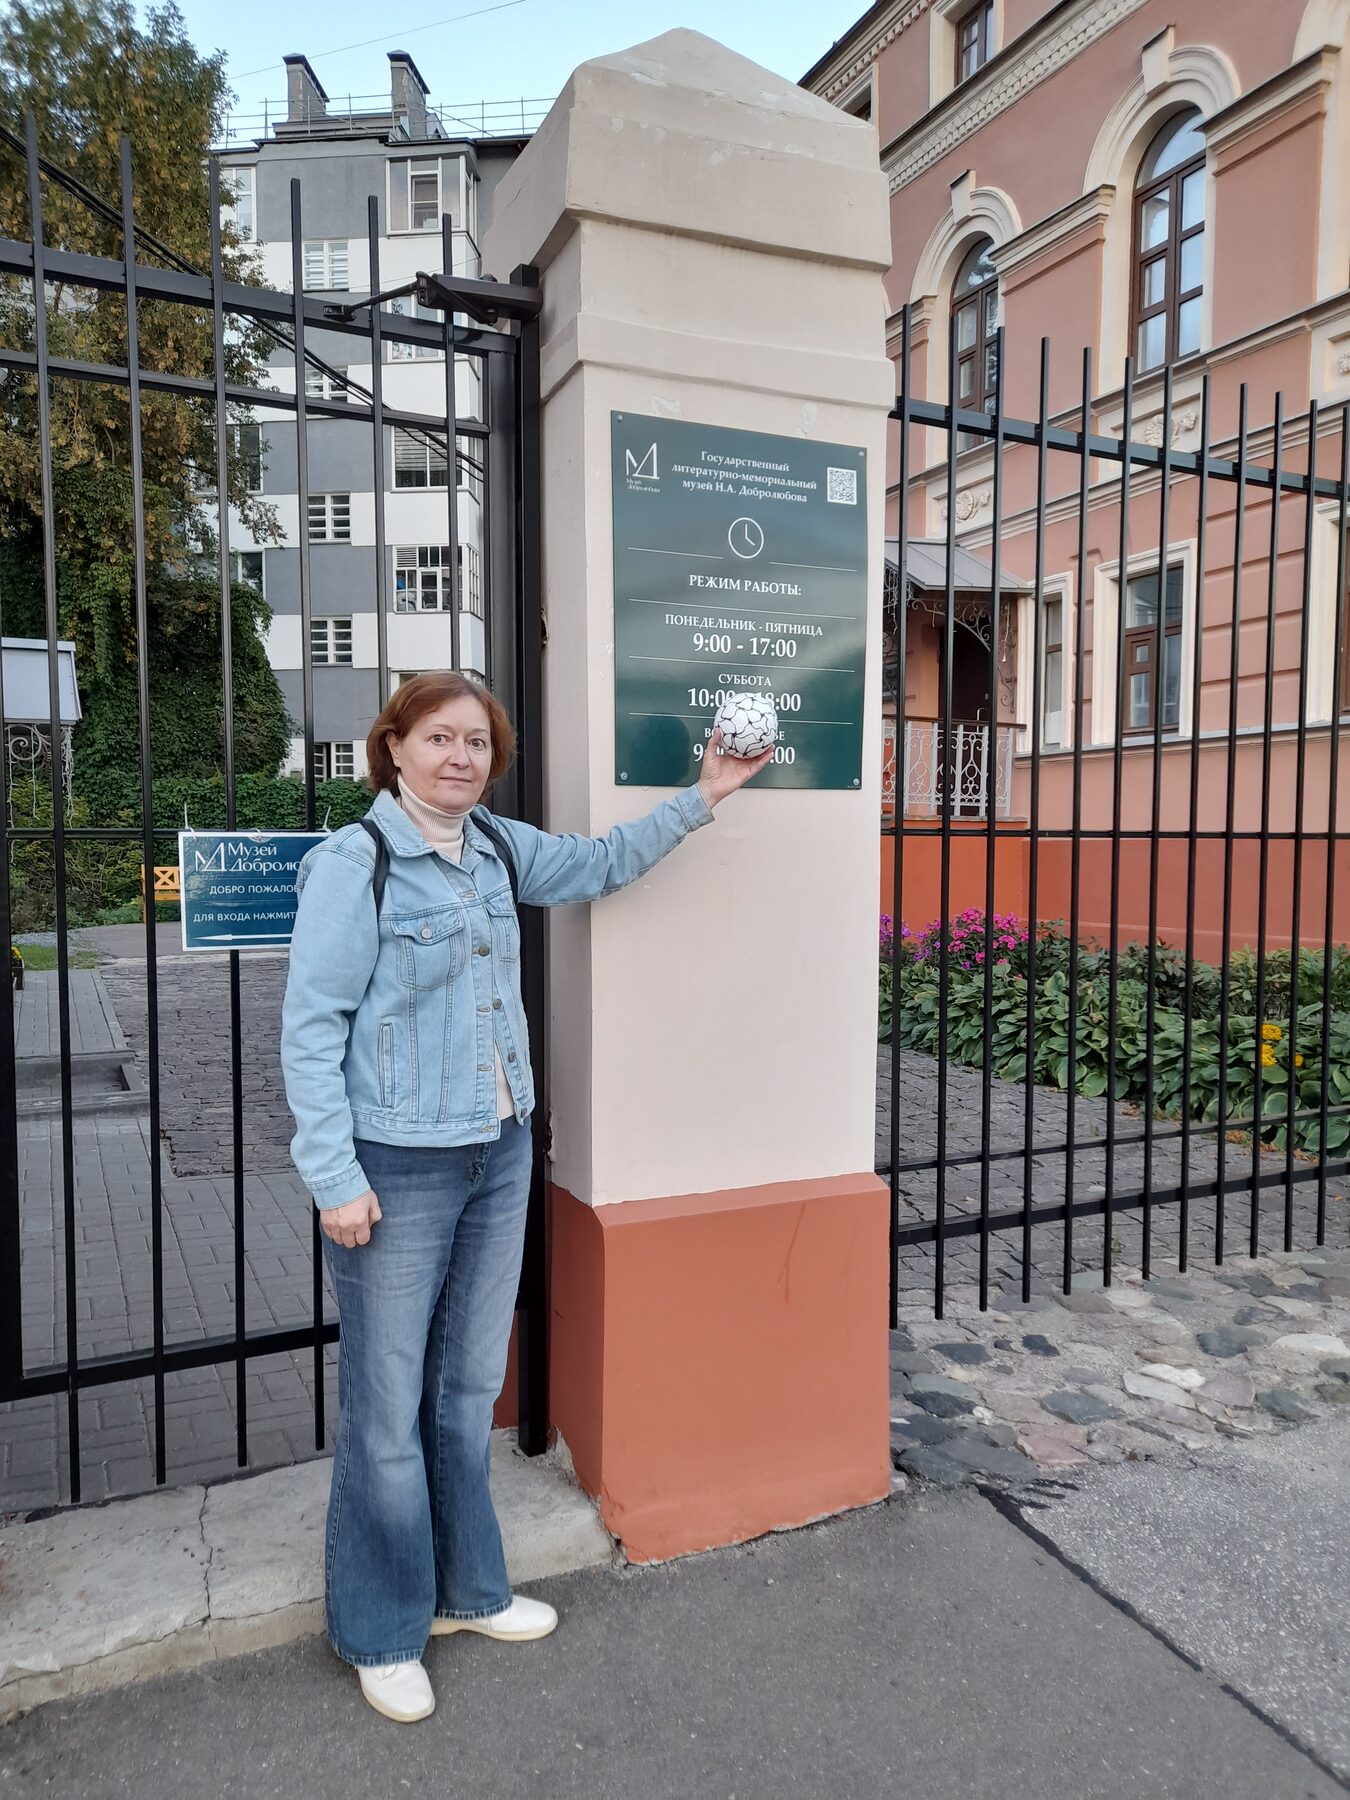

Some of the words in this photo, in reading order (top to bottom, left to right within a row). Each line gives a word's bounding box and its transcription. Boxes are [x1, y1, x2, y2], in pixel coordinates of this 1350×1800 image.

[701, 450, 790, 472] Государственный
[671, 464, 818, 490] литературно-мемориальный
[682, 479, 713, 491] музей
[715, 482, 737, 494] Н.А.
[738, 485, 807, 502] Добролюбова
[689, 574, 741, 591] РЕЖИМ
[744, 579, 802, 596] РАБОТЫ:
[665, 613, 756, 632] ПОНЕДЕЛЬНИК
[765, 622, 824, 637] ПЯТНИЦА
[693, 632, 731, 654] 9:00
[749, 636, 797, 658] 17:00
[718, 673, 772, 687] СУББОТА
[228, 842, 277, 860] Музей
[229, 858, 300, 876] Добролю
[209, 885, 245, 895] ДОБРО
[193, 913, 214, 923] ДЛЯ
[217, 912, 250, 922] ВХОДА
[253, 911, 297, 920] НАЖМИТ
